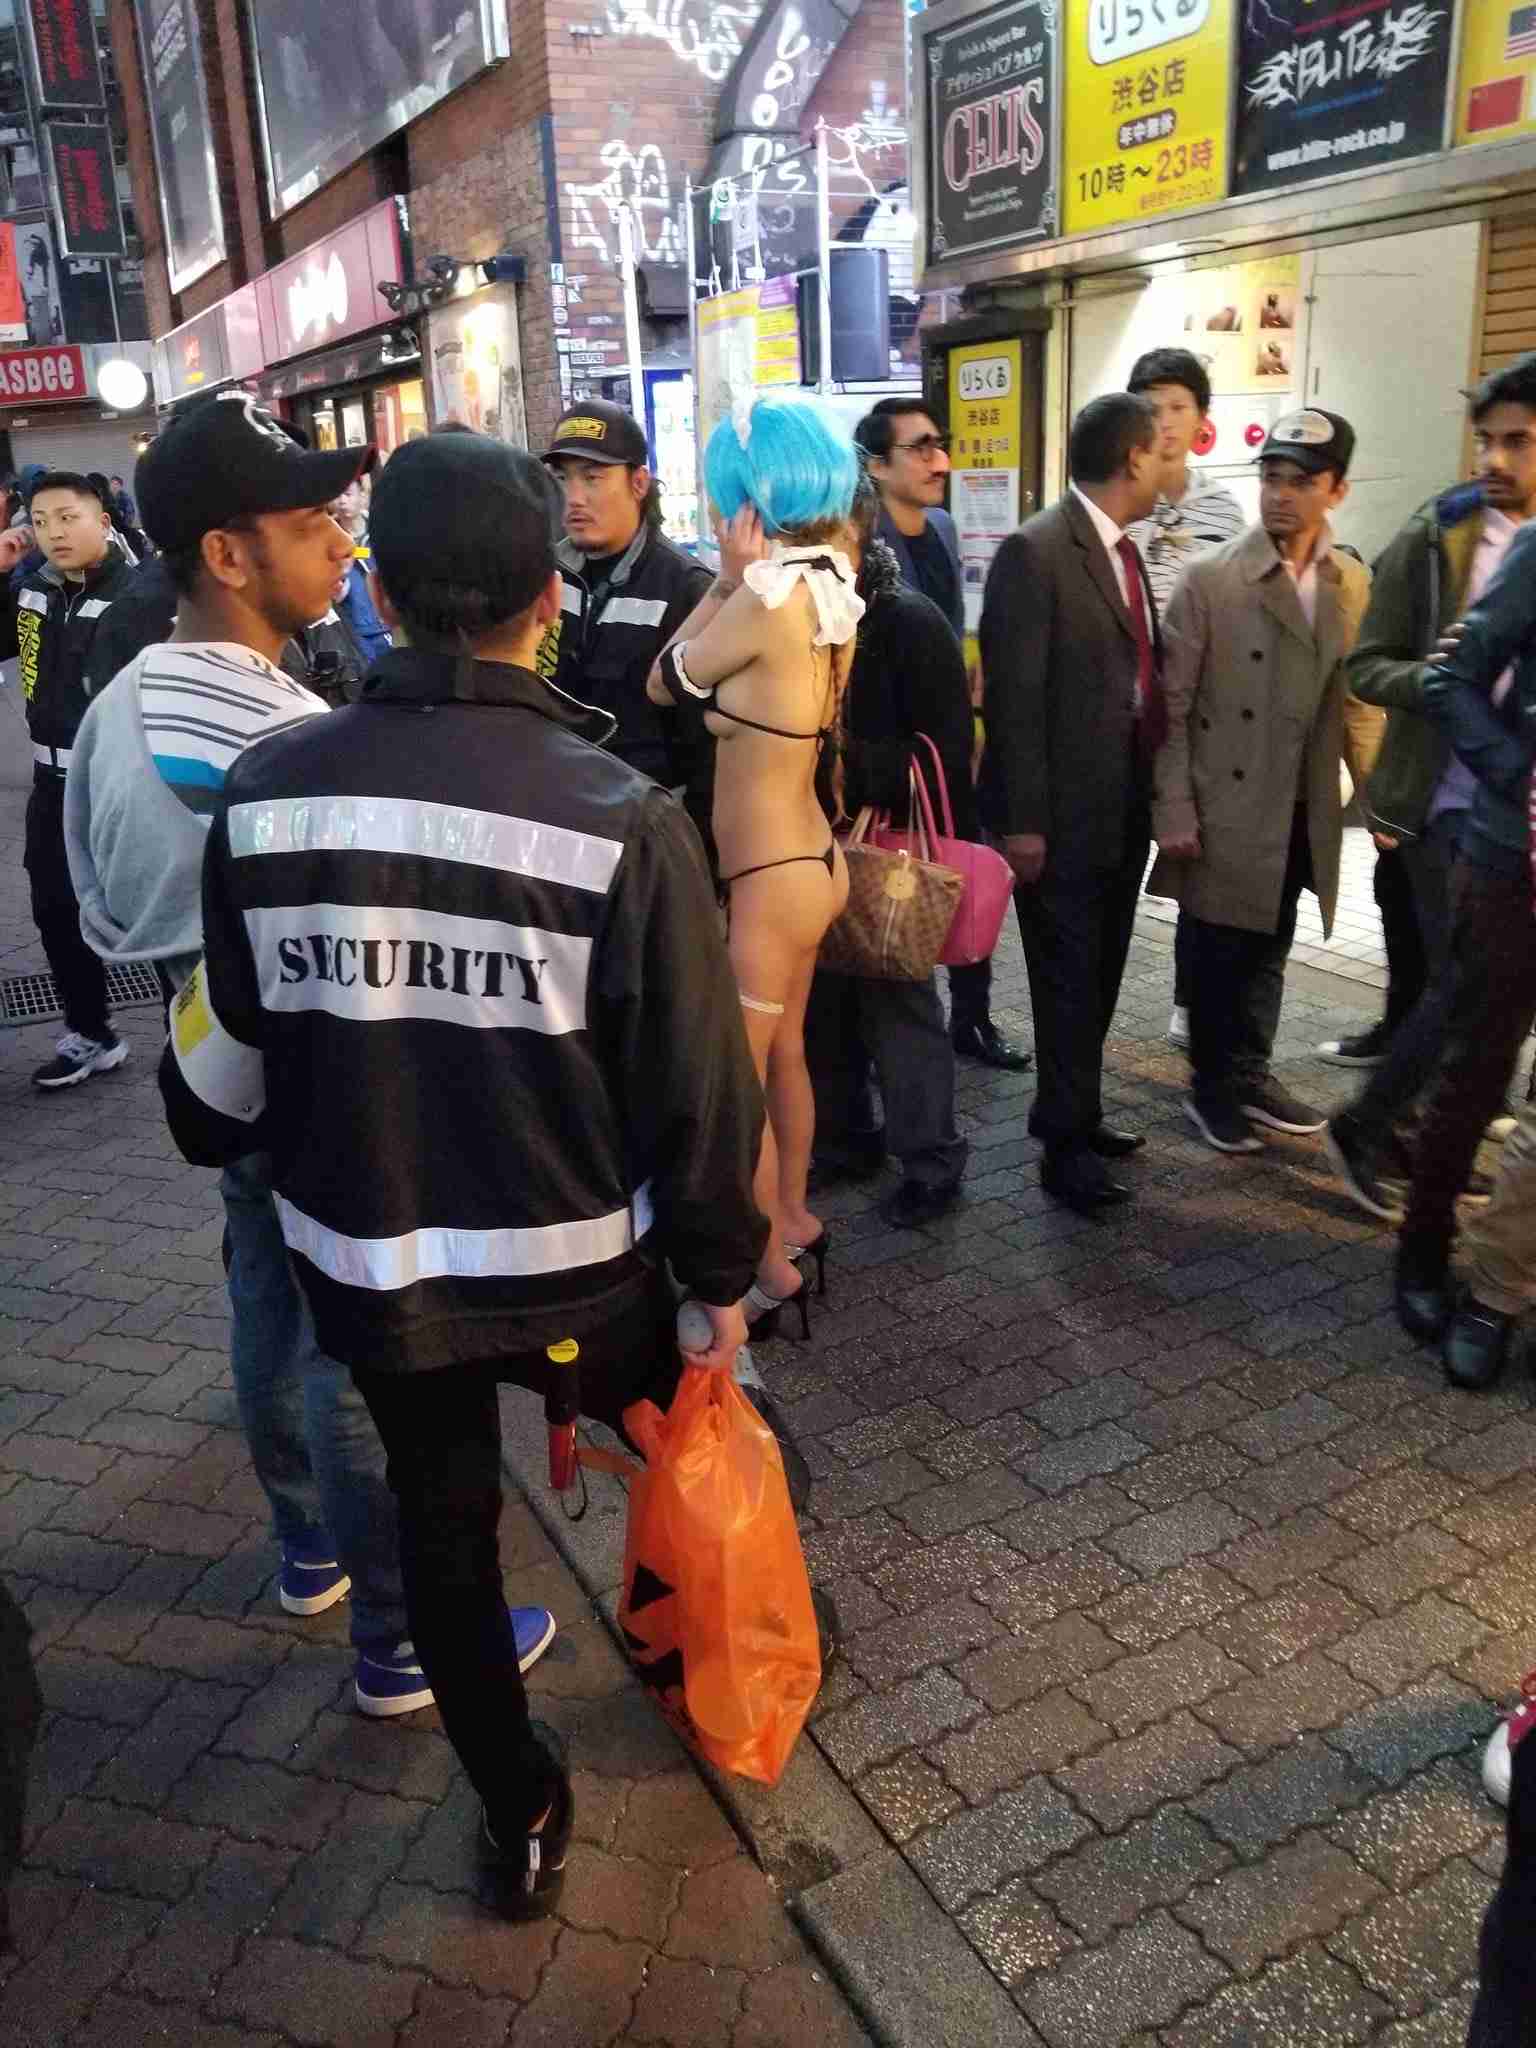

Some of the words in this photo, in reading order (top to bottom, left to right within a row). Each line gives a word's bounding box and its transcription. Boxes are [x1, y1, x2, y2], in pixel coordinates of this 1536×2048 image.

[1112, 58, 1185, 114] 渋谷店
[944, 77, 1044, 192] CELTS
[962, 365, 1007, 394] りらくる
[279, 934, 549, 1005] SECURITY
